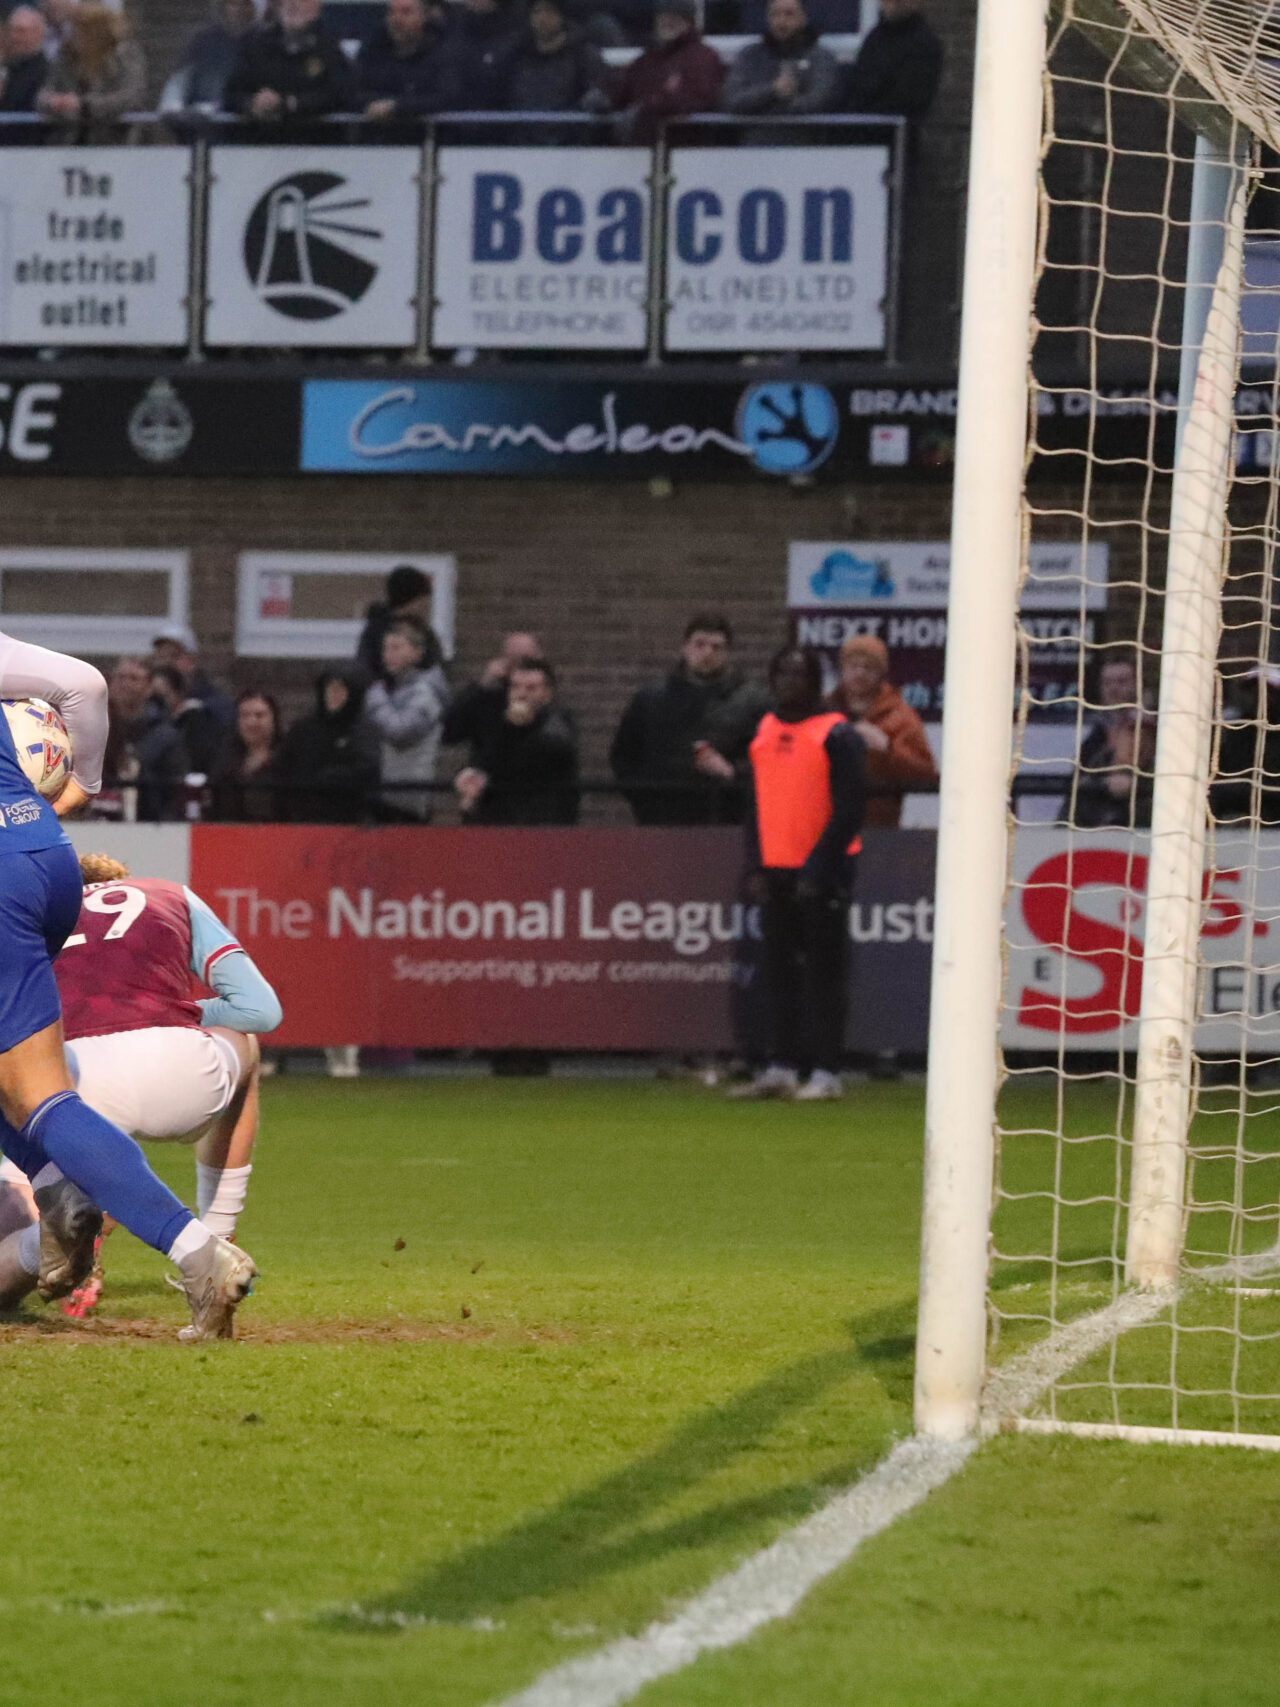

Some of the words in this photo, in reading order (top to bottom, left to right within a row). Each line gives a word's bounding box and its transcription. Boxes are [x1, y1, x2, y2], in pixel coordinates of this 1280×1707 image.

[63, 166, 112, 198] The
[48, 208, 124, 241] trade
[15, 252, 157, 285] electrical
[41, 295, 127, 327] outlet
[350, 386, 756, 458] Carmeleon
[888, 616, 948, 648] HO
[216, 887, 313, 939] The
[328, 886, 566, 939] National
[848, 896, 934, 943] ust
[392, 955, 539, 988] Supporting
[542, 959, 601, 988] your
